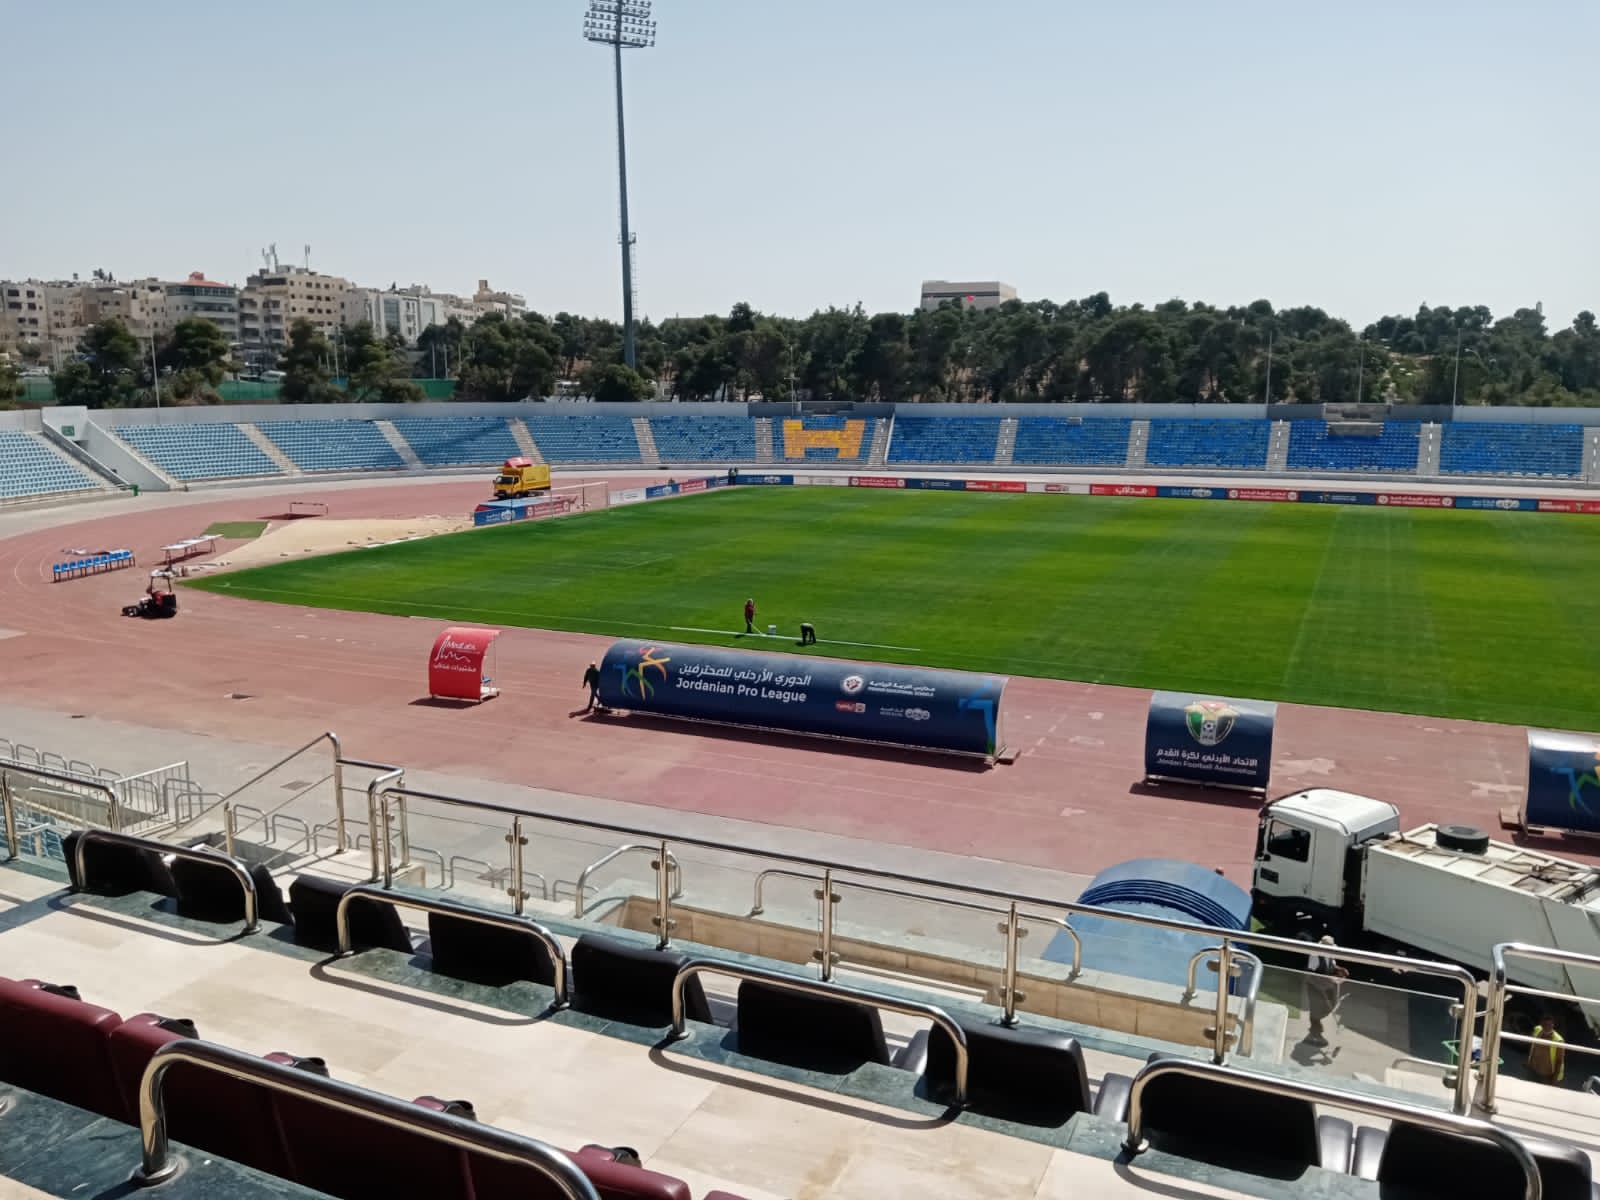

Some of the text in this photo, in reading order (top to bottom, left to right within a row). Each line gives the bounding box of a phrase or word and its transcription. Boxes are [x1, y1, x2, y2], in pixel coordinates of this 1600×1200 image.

[679, 663, 812, 688] الدوري الأردني للمحترفين
[675, 677, 807, 703] Jordanian Pro League
[1156, 748, 1258, 767] الاتحاد الأردني لكرة القدم
